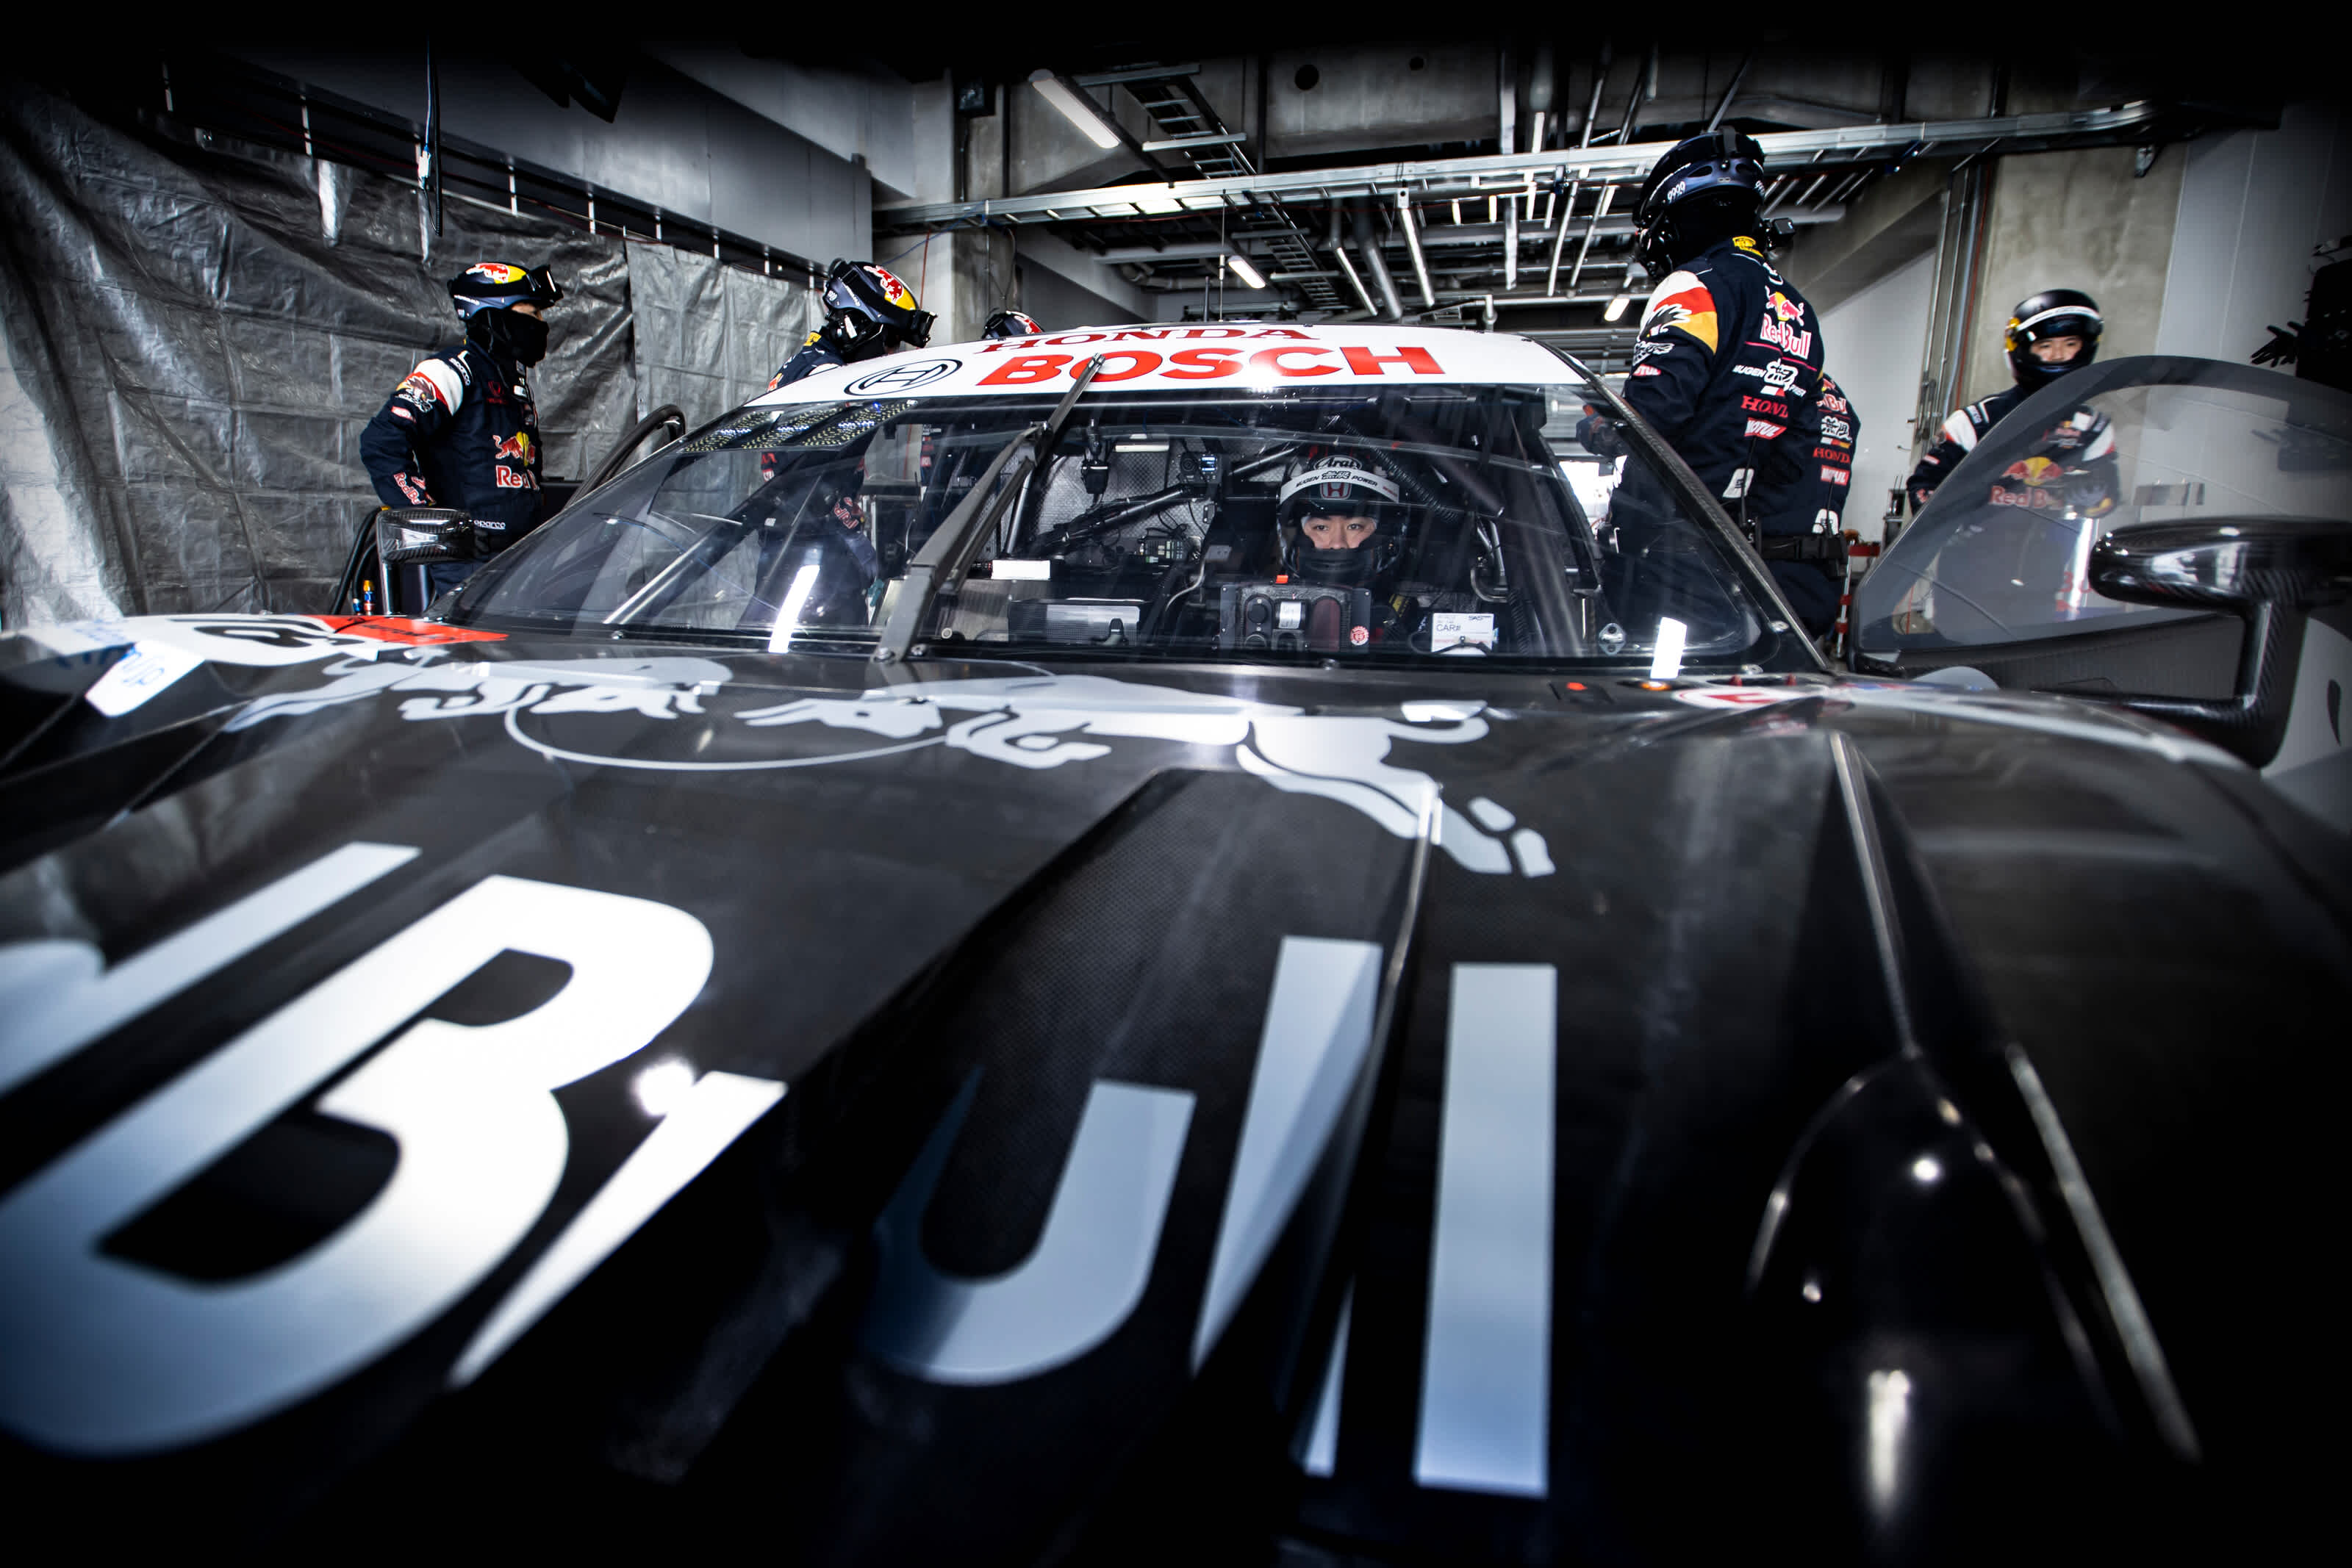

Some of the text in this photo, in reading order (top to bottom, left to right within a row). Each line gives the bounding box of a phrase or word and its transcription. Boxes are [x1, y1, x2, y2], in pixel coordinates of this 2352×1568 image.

[975, 328, 1321, 353] HONDA
[975, 347, 1446, 386] BOSCH
[1351, 475, 1378, 486] POWER
[1989, 485, 2032, 506] Red
